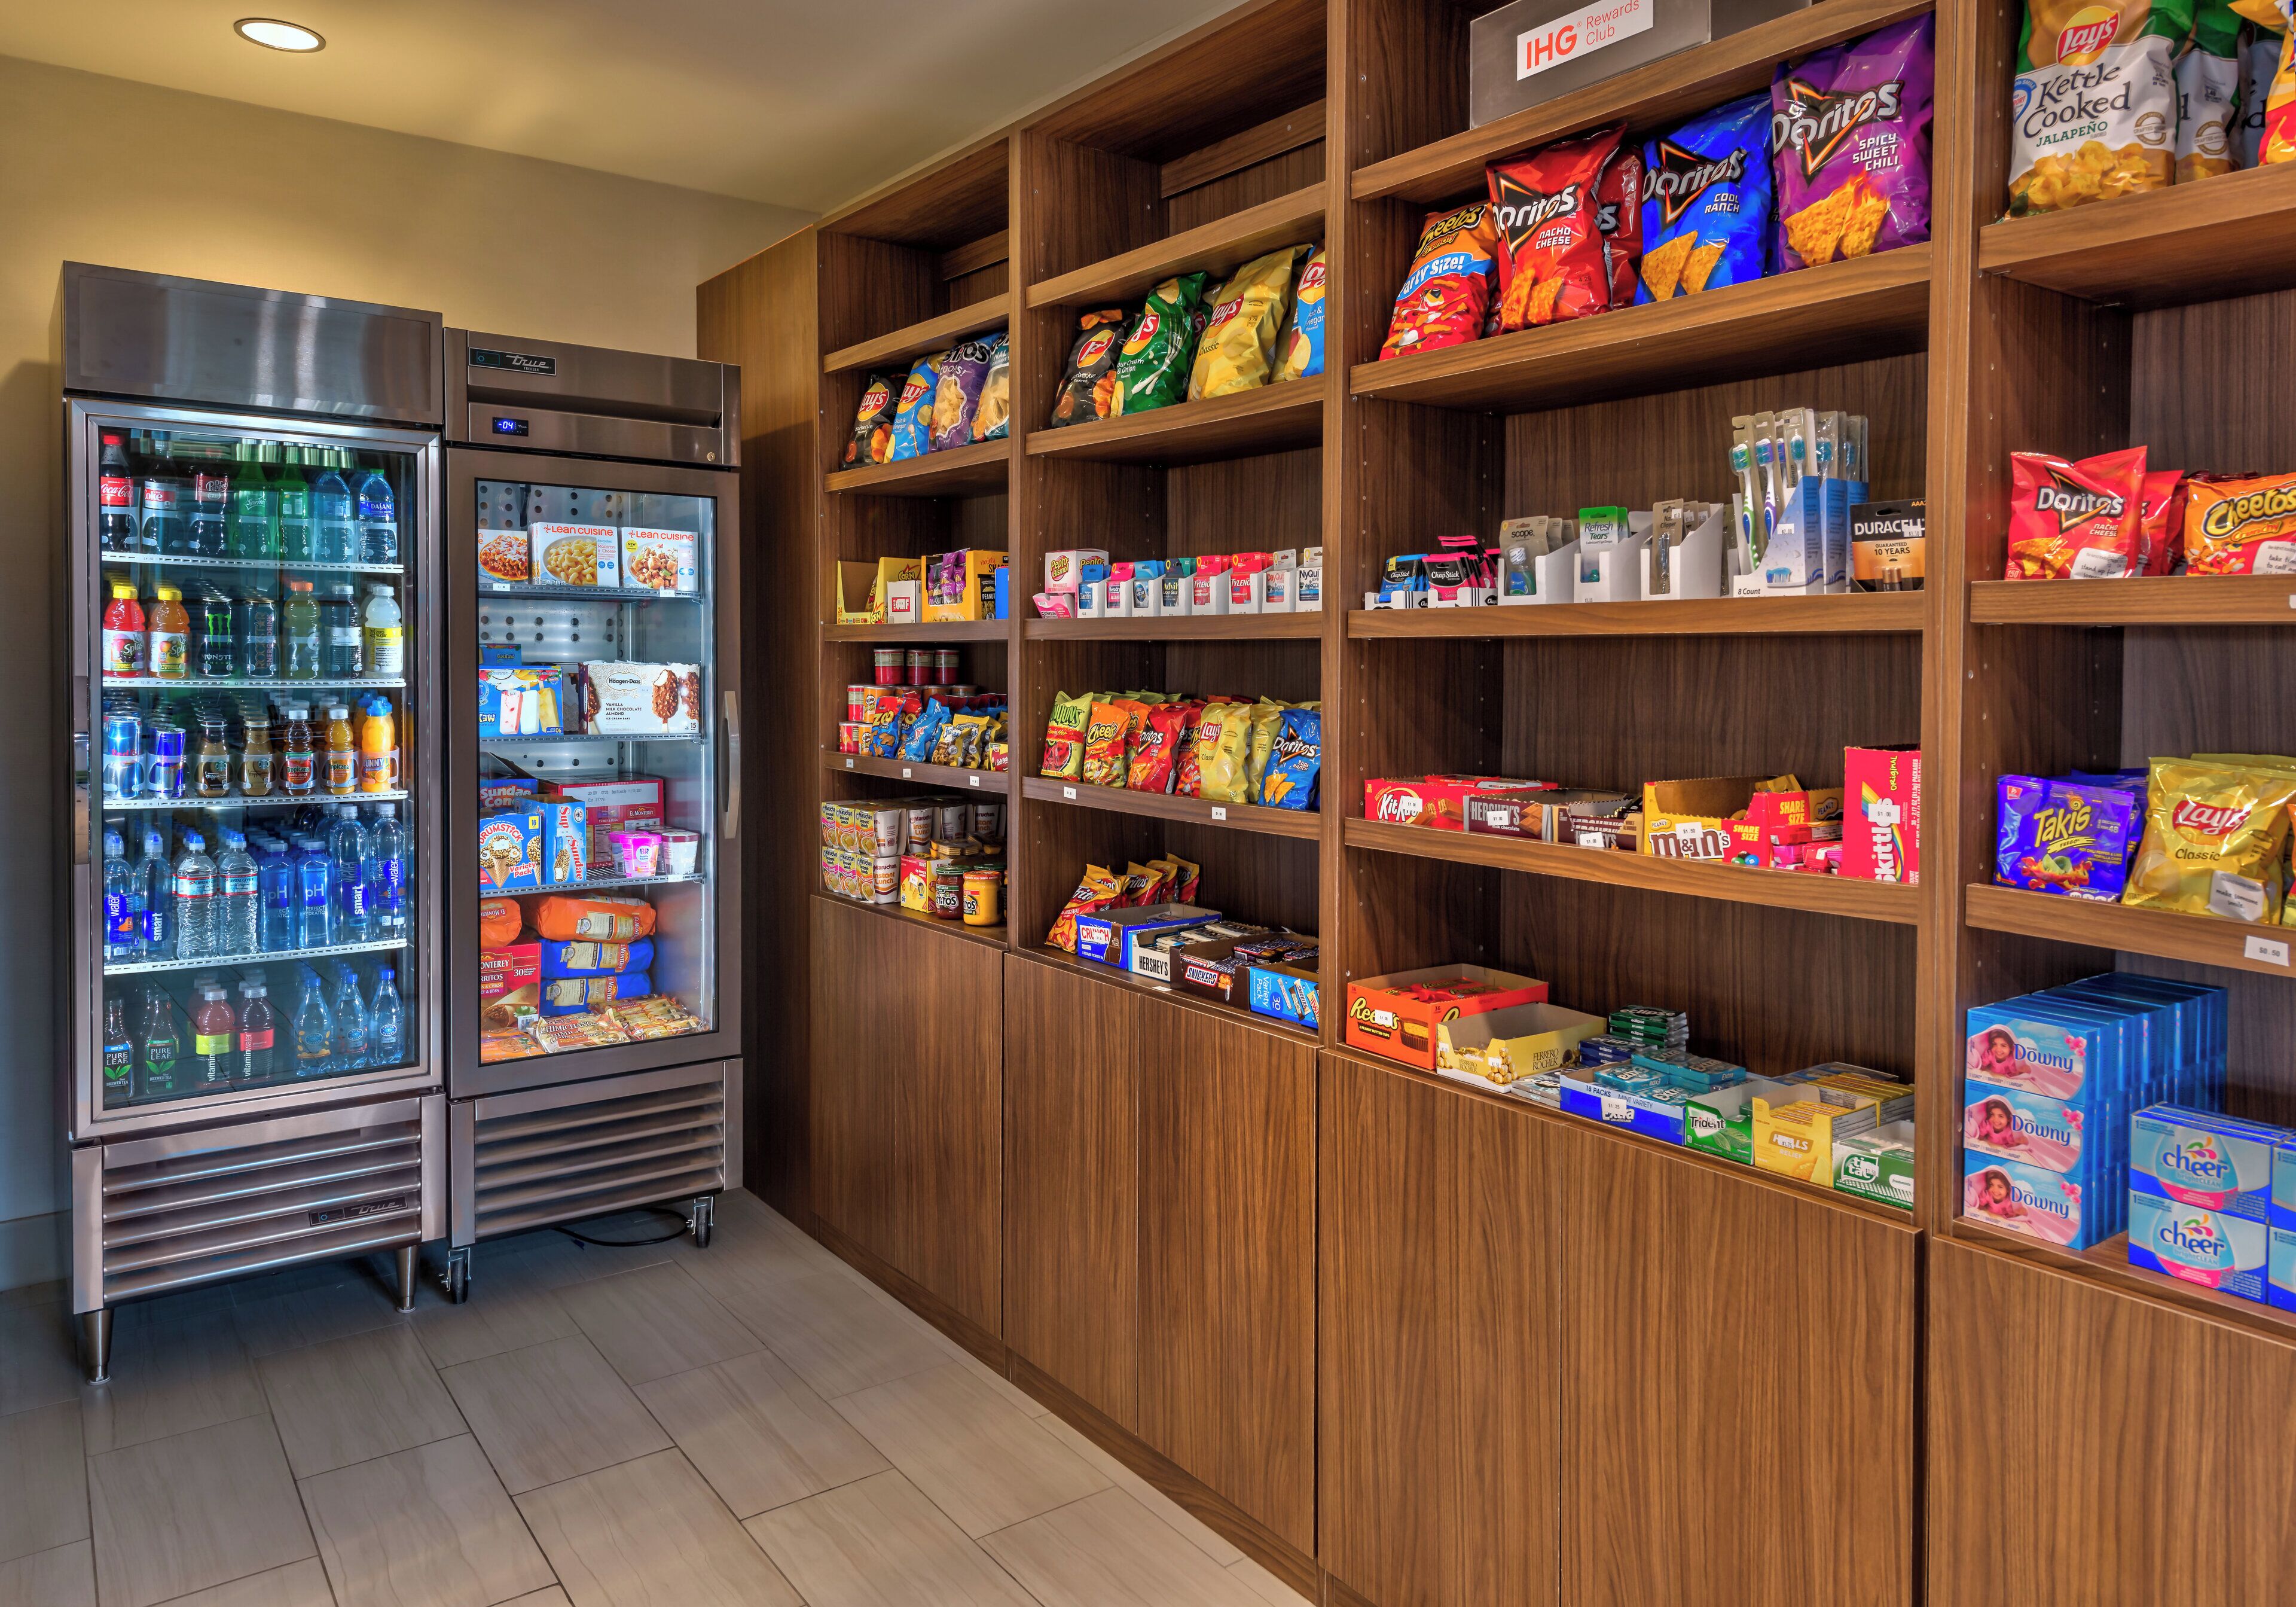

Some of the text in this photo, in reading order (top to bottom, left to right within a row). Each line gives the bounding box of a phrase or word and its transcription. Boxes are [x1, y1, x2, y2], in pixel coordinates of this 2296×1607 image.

[1526, 0, 1639, 69] IHG Rewards
[1586, 24, 1616, 45] Club
[2059, 15, 2120, 55] Lay's
[2035, 63, 2121, 110] Kettle
[2023, 82, 2131, 139] Cooked
[1773, 83, 1901, 154] Doritos
[1858, 132, 1897, 150] SPICY
[2036, 120, 2108, 148] JALAPEÑO
[1852, 145, 1898, 164] SWEET
[1865, 155, 1898, 172] CHILI
[1642, 150, 1746, 202] Doritos
[1714, 193, 1739, 204] COOL
[1705, 203, 1740, 214] RANCH
[1539, 226, 1571, 240] NACHO
[1535, 236, 1571, 249] CHEESE
[1430, 255, 1465, 275] Size!
[1199, 341, 1220, 356] Classic
[2036, 486, 2126, 519] Doritos
[1511, 529, 1534, 539] scope
[1584, 520, 1613, 533] Refresh
[2089, 529, 2118, 537] CHEESE
[1885, 547, 1910, 555] YEARS
[1052, 565, 1069, 578] Bismol
[1431, 571, 1460, 580] ChapStick
[1193, 580, 1210, 588] TYLENO
[1273, 736, 1319, 757] Doritos
[480, 785, 532, 799] Sundae
[1779, 800, 1805, 815] SHARE
[1788, 812, 1805, 825] SIZE
[2175, 801, 2247, 835] Lay's
[1733, 824, 1760, 834] SHARE
[2034, 806, 2092, 847] Takis
[1741, 833, 1759, 841] SIZE
[568, 839, 584, 880] Sundae
[2175, 847, 2221, 862] Classic
[388, 859, 398, 885] water
[509, 861, 537, 873] Variety
[514, 868, 533, 879] Pack
[306, 883, 325, 901] pH
[353, 885, 364, 916] smart
[153, 911, 163, 942] smart
[514, 968, 524, 977] 30
[1139, 955, 1168, 976] HERSHEY'S
[1459, 1058, 1477, 1067] FERRERO
[1532, 1048, 1559, 1062] FERRERO
[2013, 1043, 2074, 1074] Downy
[1460, 1063, 1477, 1073] ROCHER
[1532, 1057, 1559, 1071] ROCHER
[1592, 1087, 1611, 1097] PACKS
[1631, 1097, 1653, 1109] VARIETY
[2011, 1113, 2071, 1146] Downy
[1779, 1149, 1803, 1160] RELIEF
[2162, 1143, 2228, 1179] cheer
[2010, 1185, 2069, 1219] Downy
[2159, 1220, 2225, 1257] cheer
